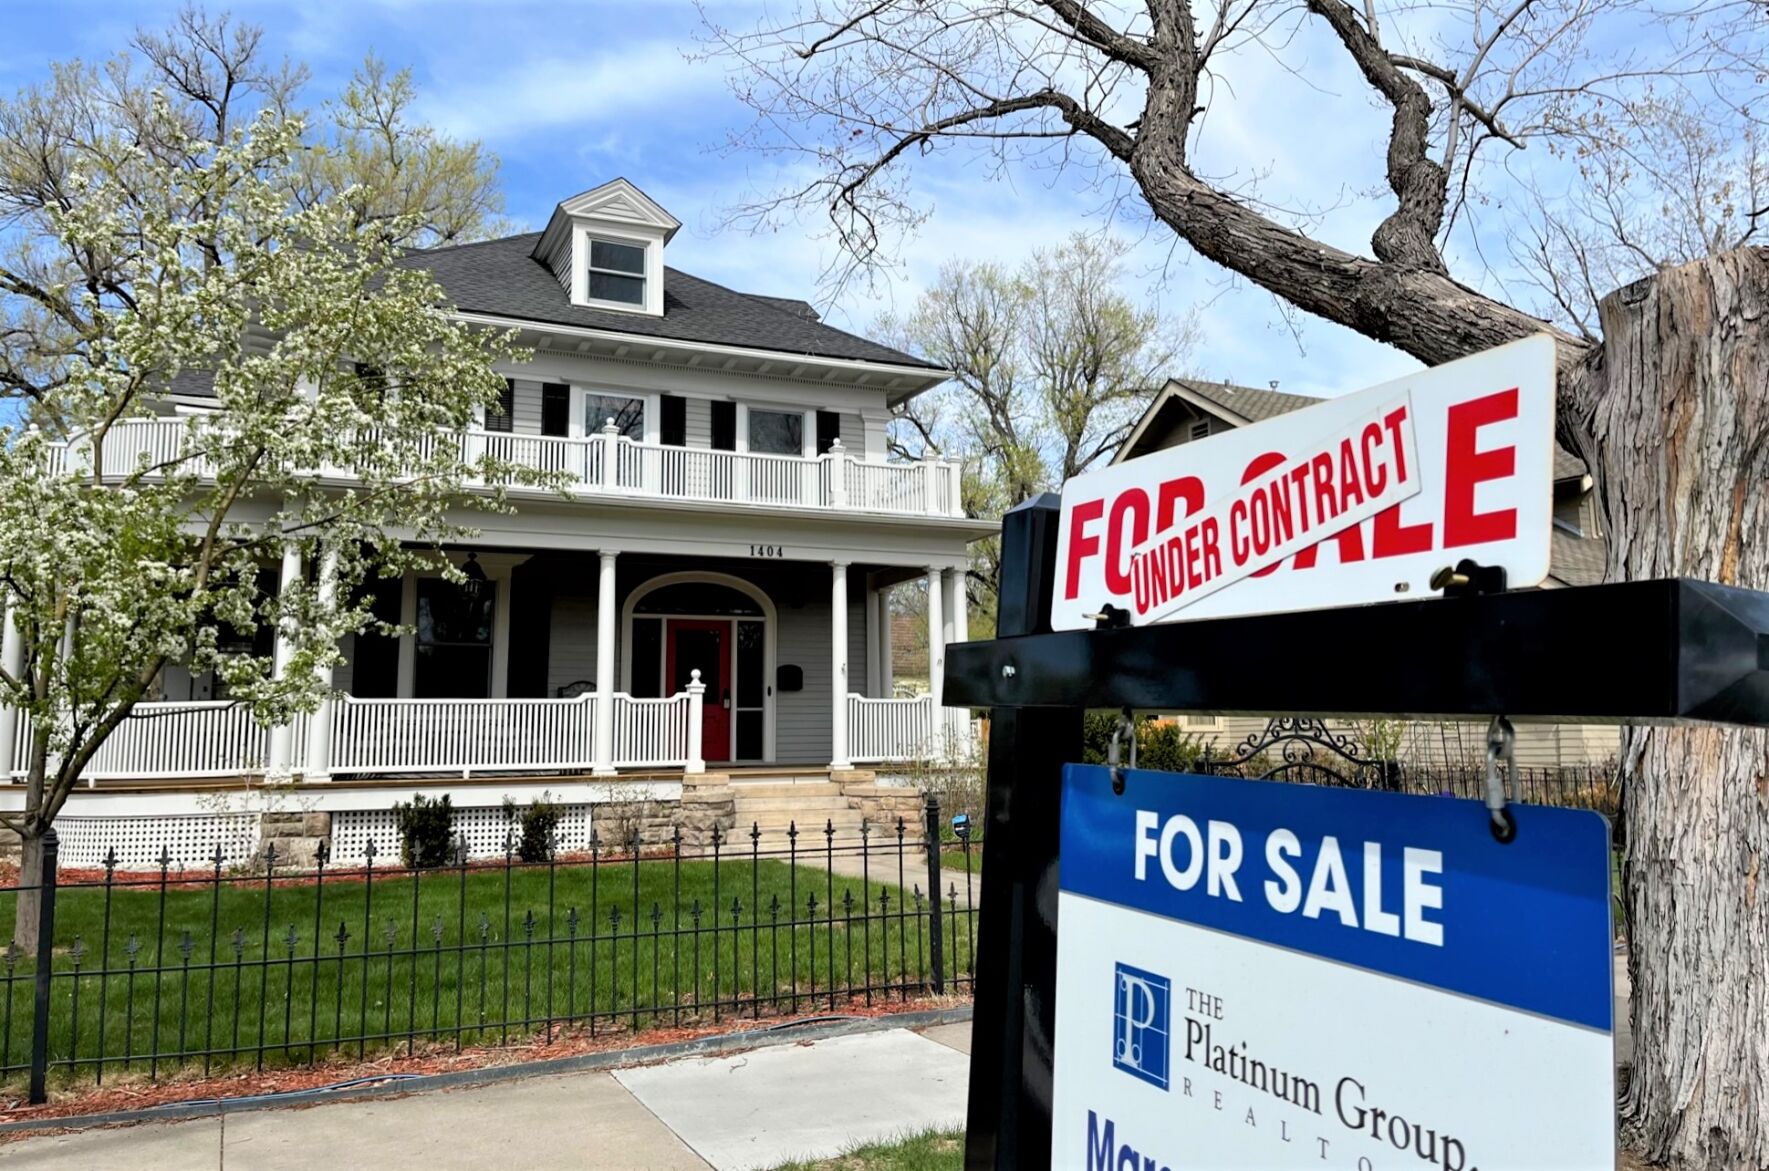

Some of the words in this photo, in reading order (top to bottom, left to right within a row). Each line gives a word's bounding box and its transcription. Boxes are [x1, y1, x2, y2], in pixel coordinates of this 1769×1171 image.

[750, 544, 783, 558] 1404
[1131, 516, 1222, 615] UNDER
[1230, 406, 1408, 567] CONTRACT
[1135, 810, 1243, 902] FOR
[1265, 829, 1444, 947] SALE
[1186, 987, 1224, 1020] THE
[1184, 1017, 1322, 1115] Platinum
[1335, 1077, 1479, 1171] Group
